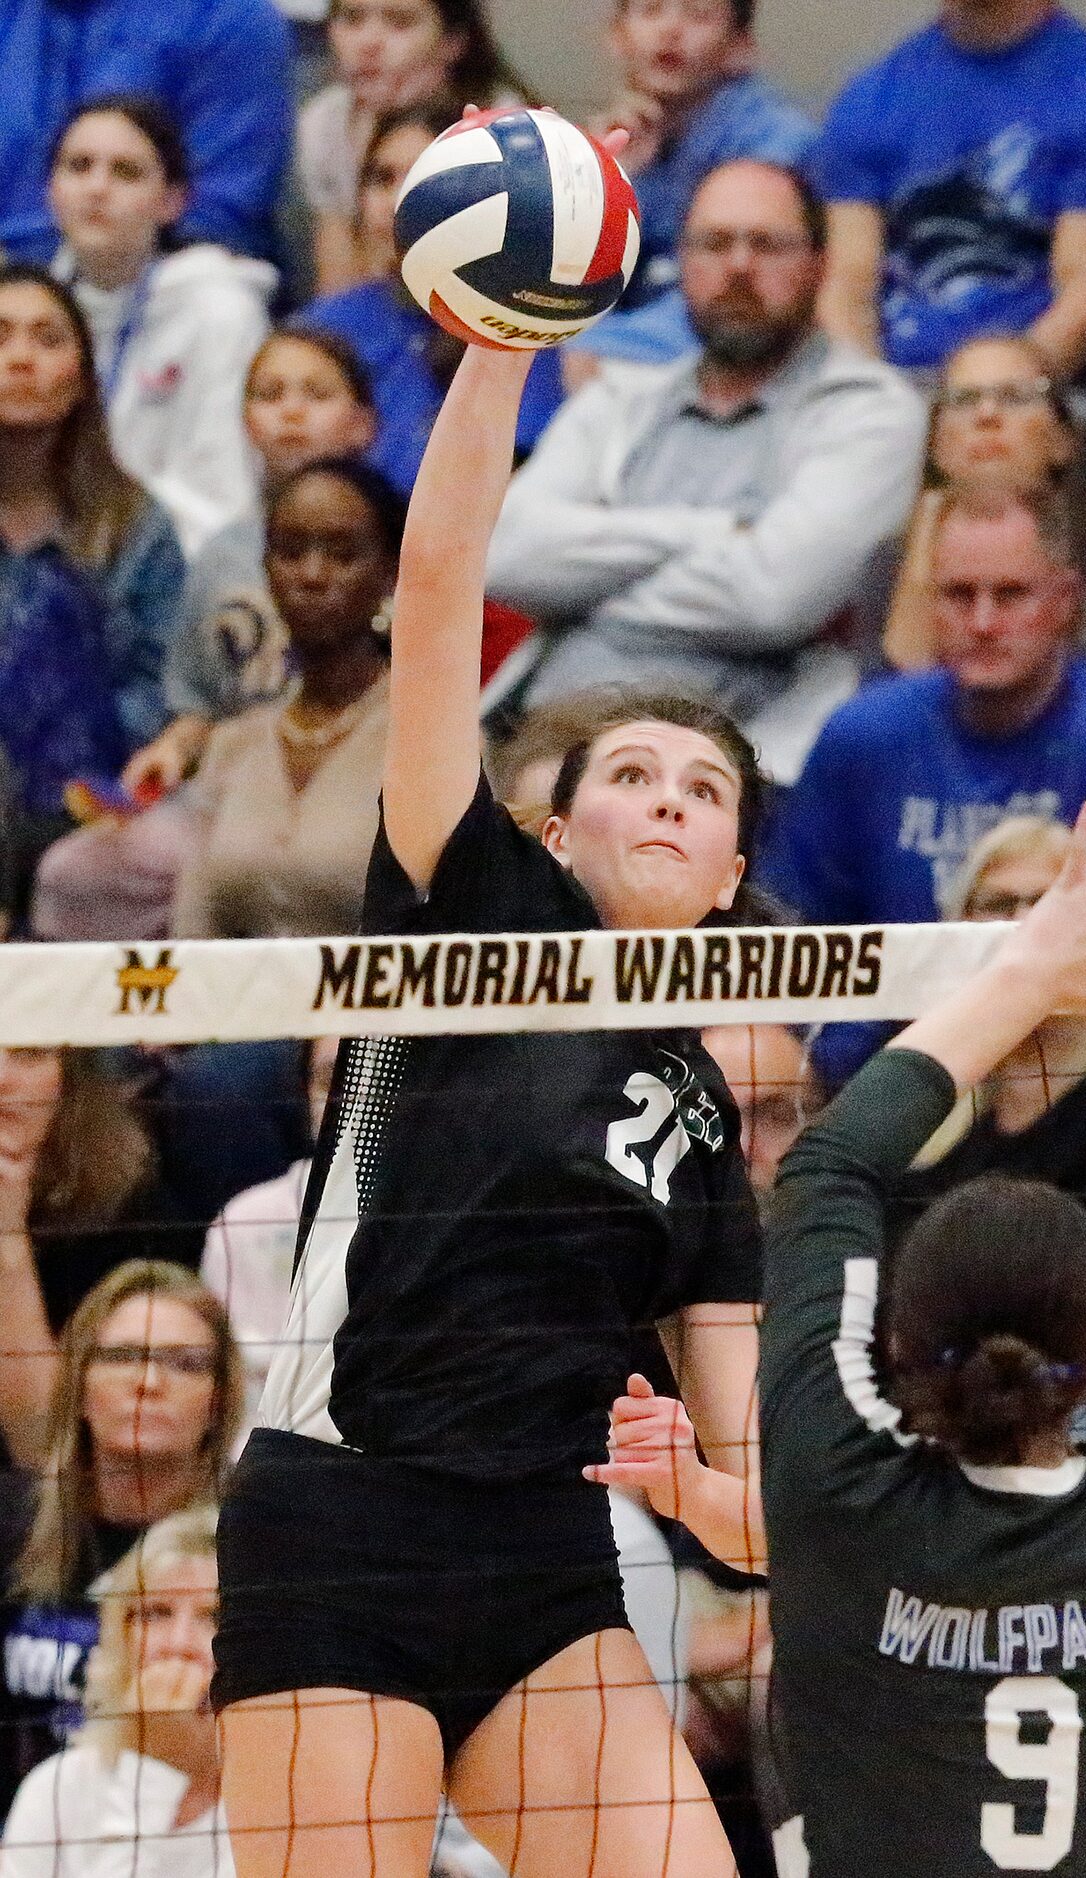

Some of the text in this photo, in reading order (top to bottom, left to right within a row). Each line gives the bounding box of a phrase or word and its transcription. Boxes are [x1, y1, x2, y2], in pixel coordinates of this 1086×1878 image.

[312, 929, 884, 1010] MEMORIAL WARRIORS
[979, 1676, 1084, 1871] 9
